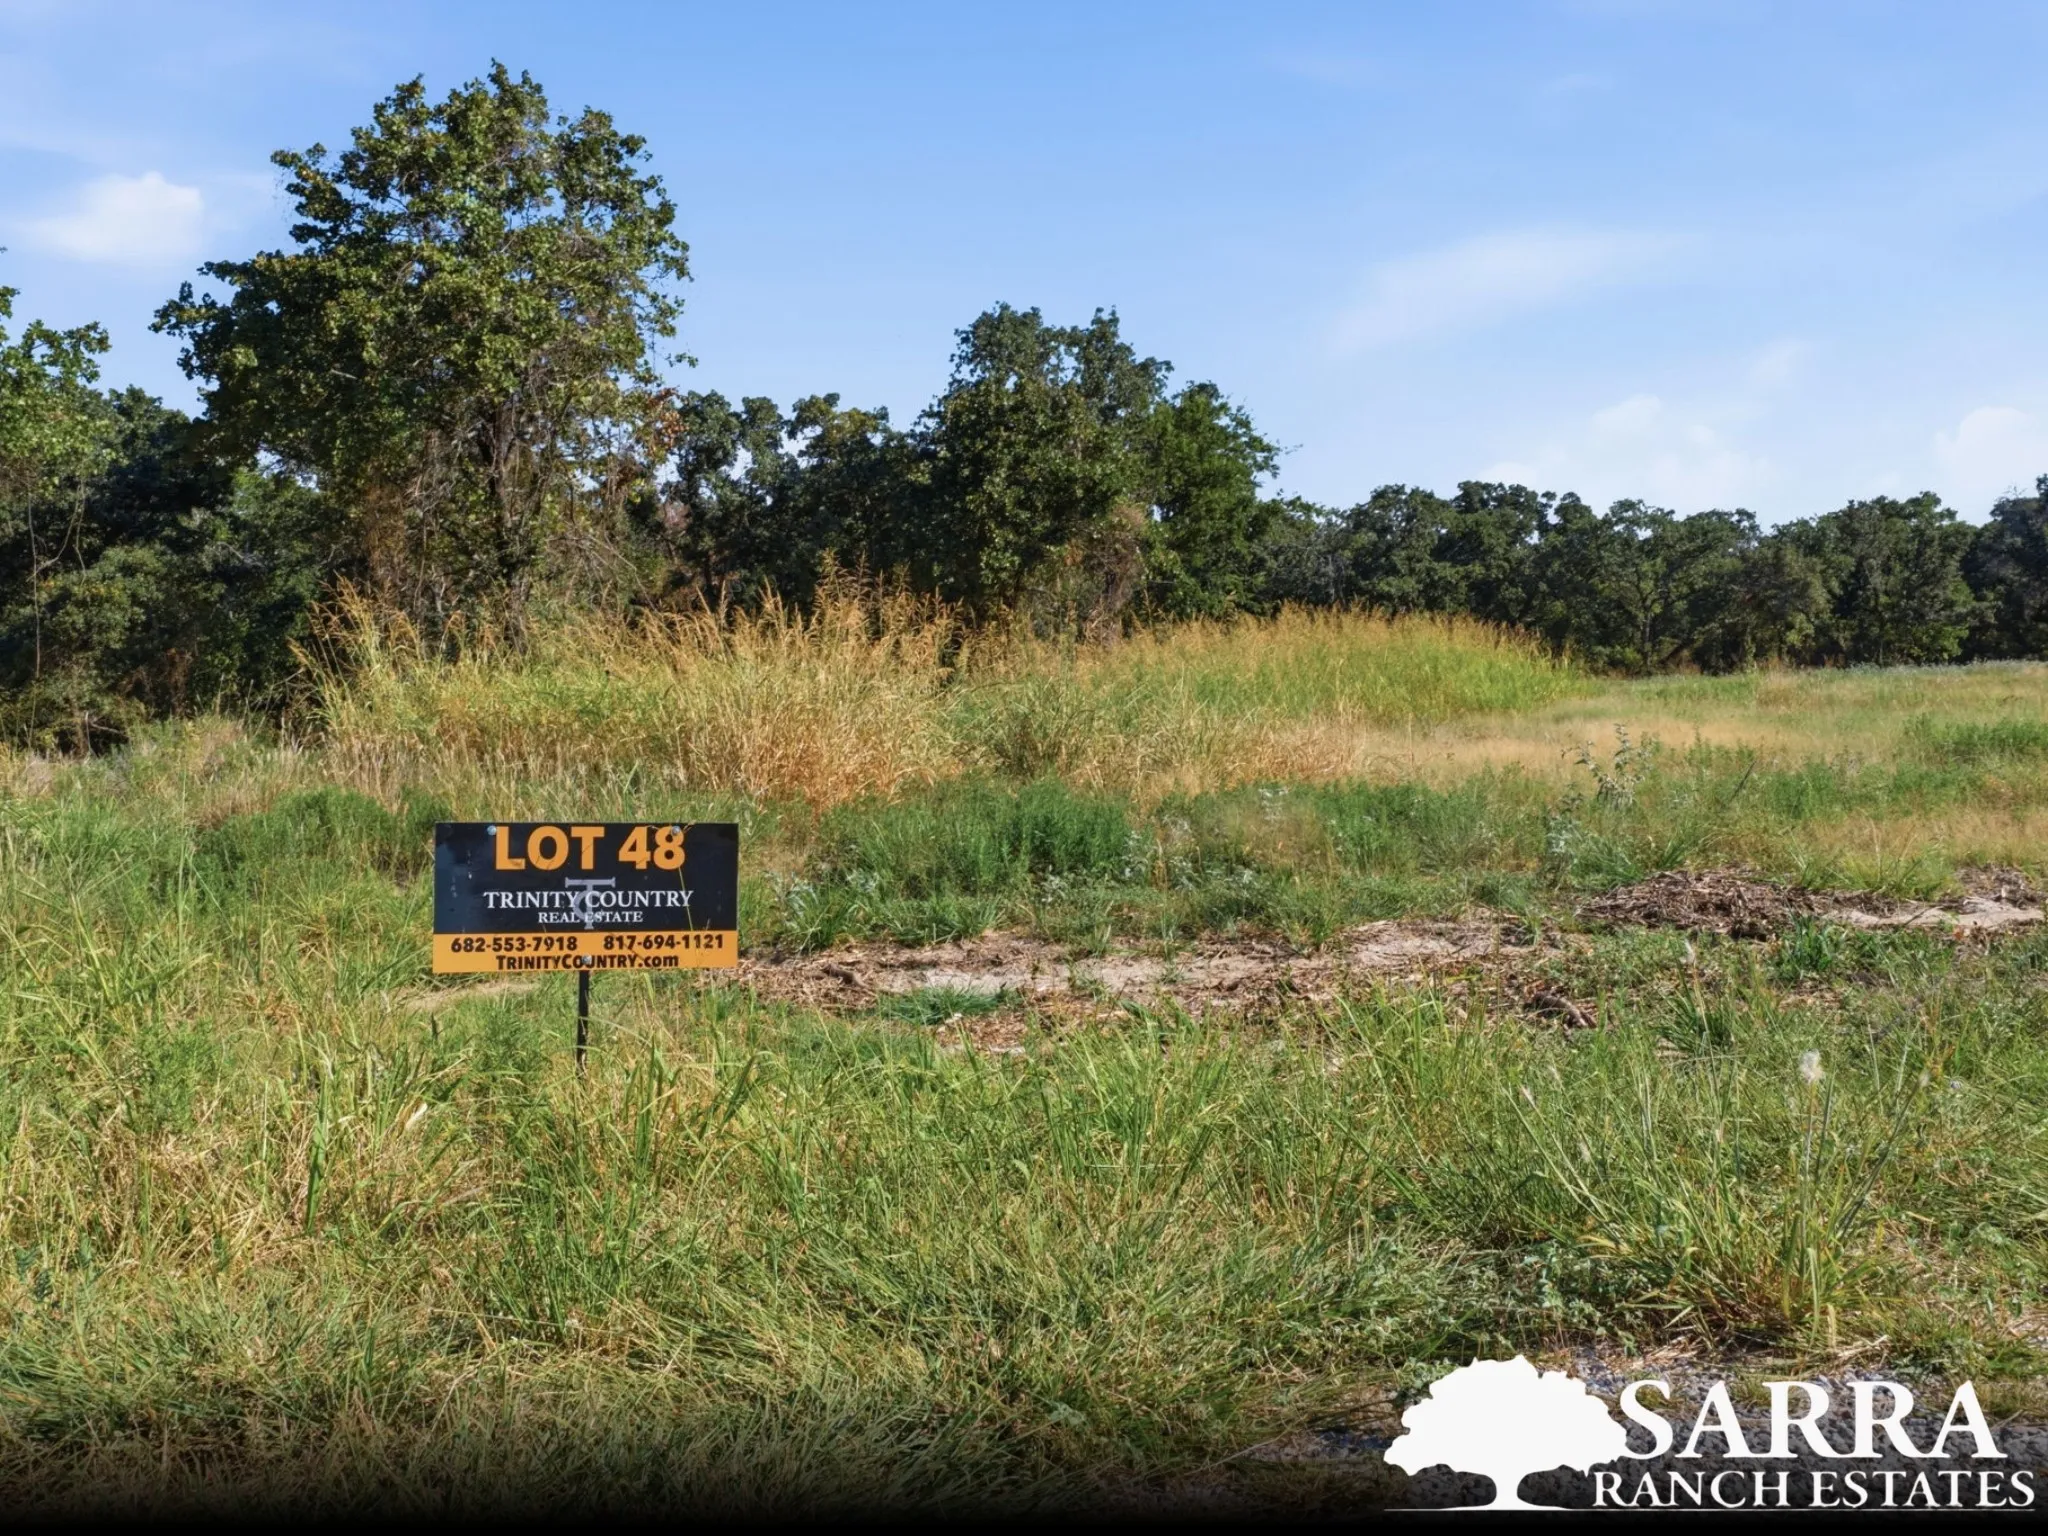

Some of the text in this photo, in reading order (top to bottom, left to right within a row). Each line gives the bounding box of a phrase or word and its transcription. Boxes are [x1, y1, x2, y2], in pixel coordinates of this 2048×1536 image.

[494, 826, 686, 871] LOT 48
[483, 890, 694, 909] TRINITY COUNTRY
[538, 911, 643, 924] REAL ESTATE
[450, 934, 724, 953] 682-553-7918 817-694-1121
